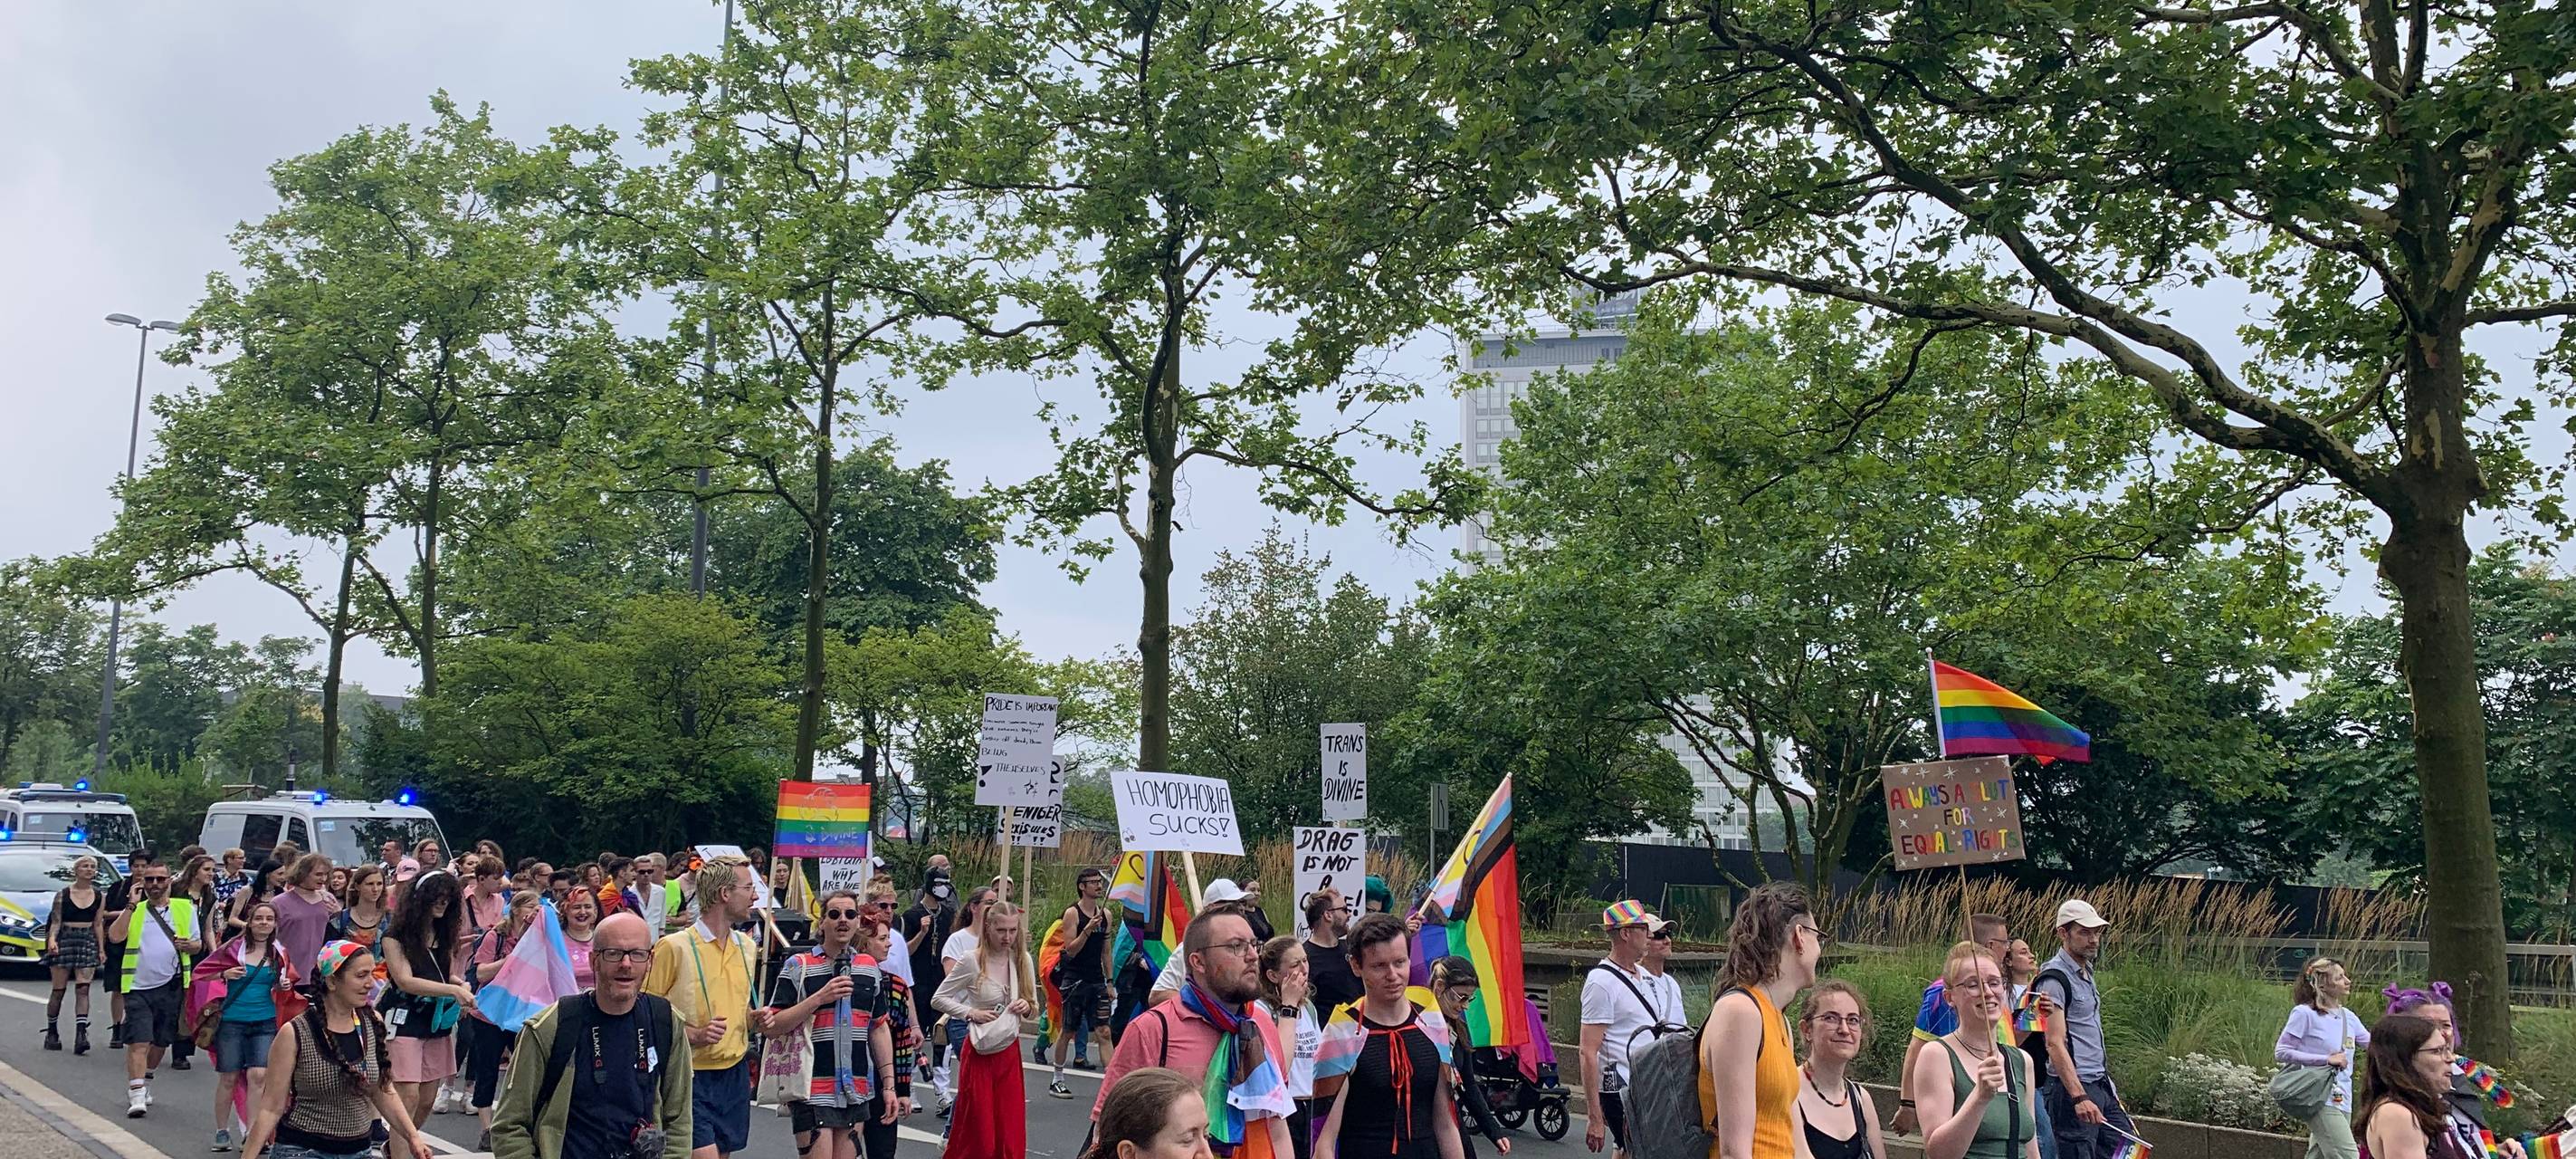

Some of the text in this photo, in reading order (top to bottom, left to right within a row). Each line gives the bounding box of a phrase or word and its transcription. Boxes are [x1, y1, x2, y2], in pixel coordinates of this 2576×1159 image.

[985, 696, 1013, 712] PRIDE
[1015, 702, 1022, 711] IS
[1324, 734, 1364, 752] TRANS
[996, 762, 1046, 776] THEMSELVES
[1339, 761, 1349, 777] IS
[1125, 779, 1230, 814] HOMOPHOBIA
[1324, 777, 1365, 802] DIVINE
[1890, 783, 1951, 810] ALWAYS
[1954, 783, 1966, 804] A
[1003, 803, 1062, 823] ENIGER
[1943, 807, 1975, 826] FOR
[1149, 813, 1230, 838] SUCKS!
[1296, 829, 1359, 853] DRAG
[1901, 829, 2020, 856] EQUAL RIGHTS
[1302, 854, 1359, 872] IS NOT
[833, 869, 858, 882] WHY
[1319, 874, 1332, 891] A
[822, 880, 861, 891] ARE WE
[592, 1026, 603, 1068] LUMIX G
[637, 1028, 645, 1059] LUMIX
